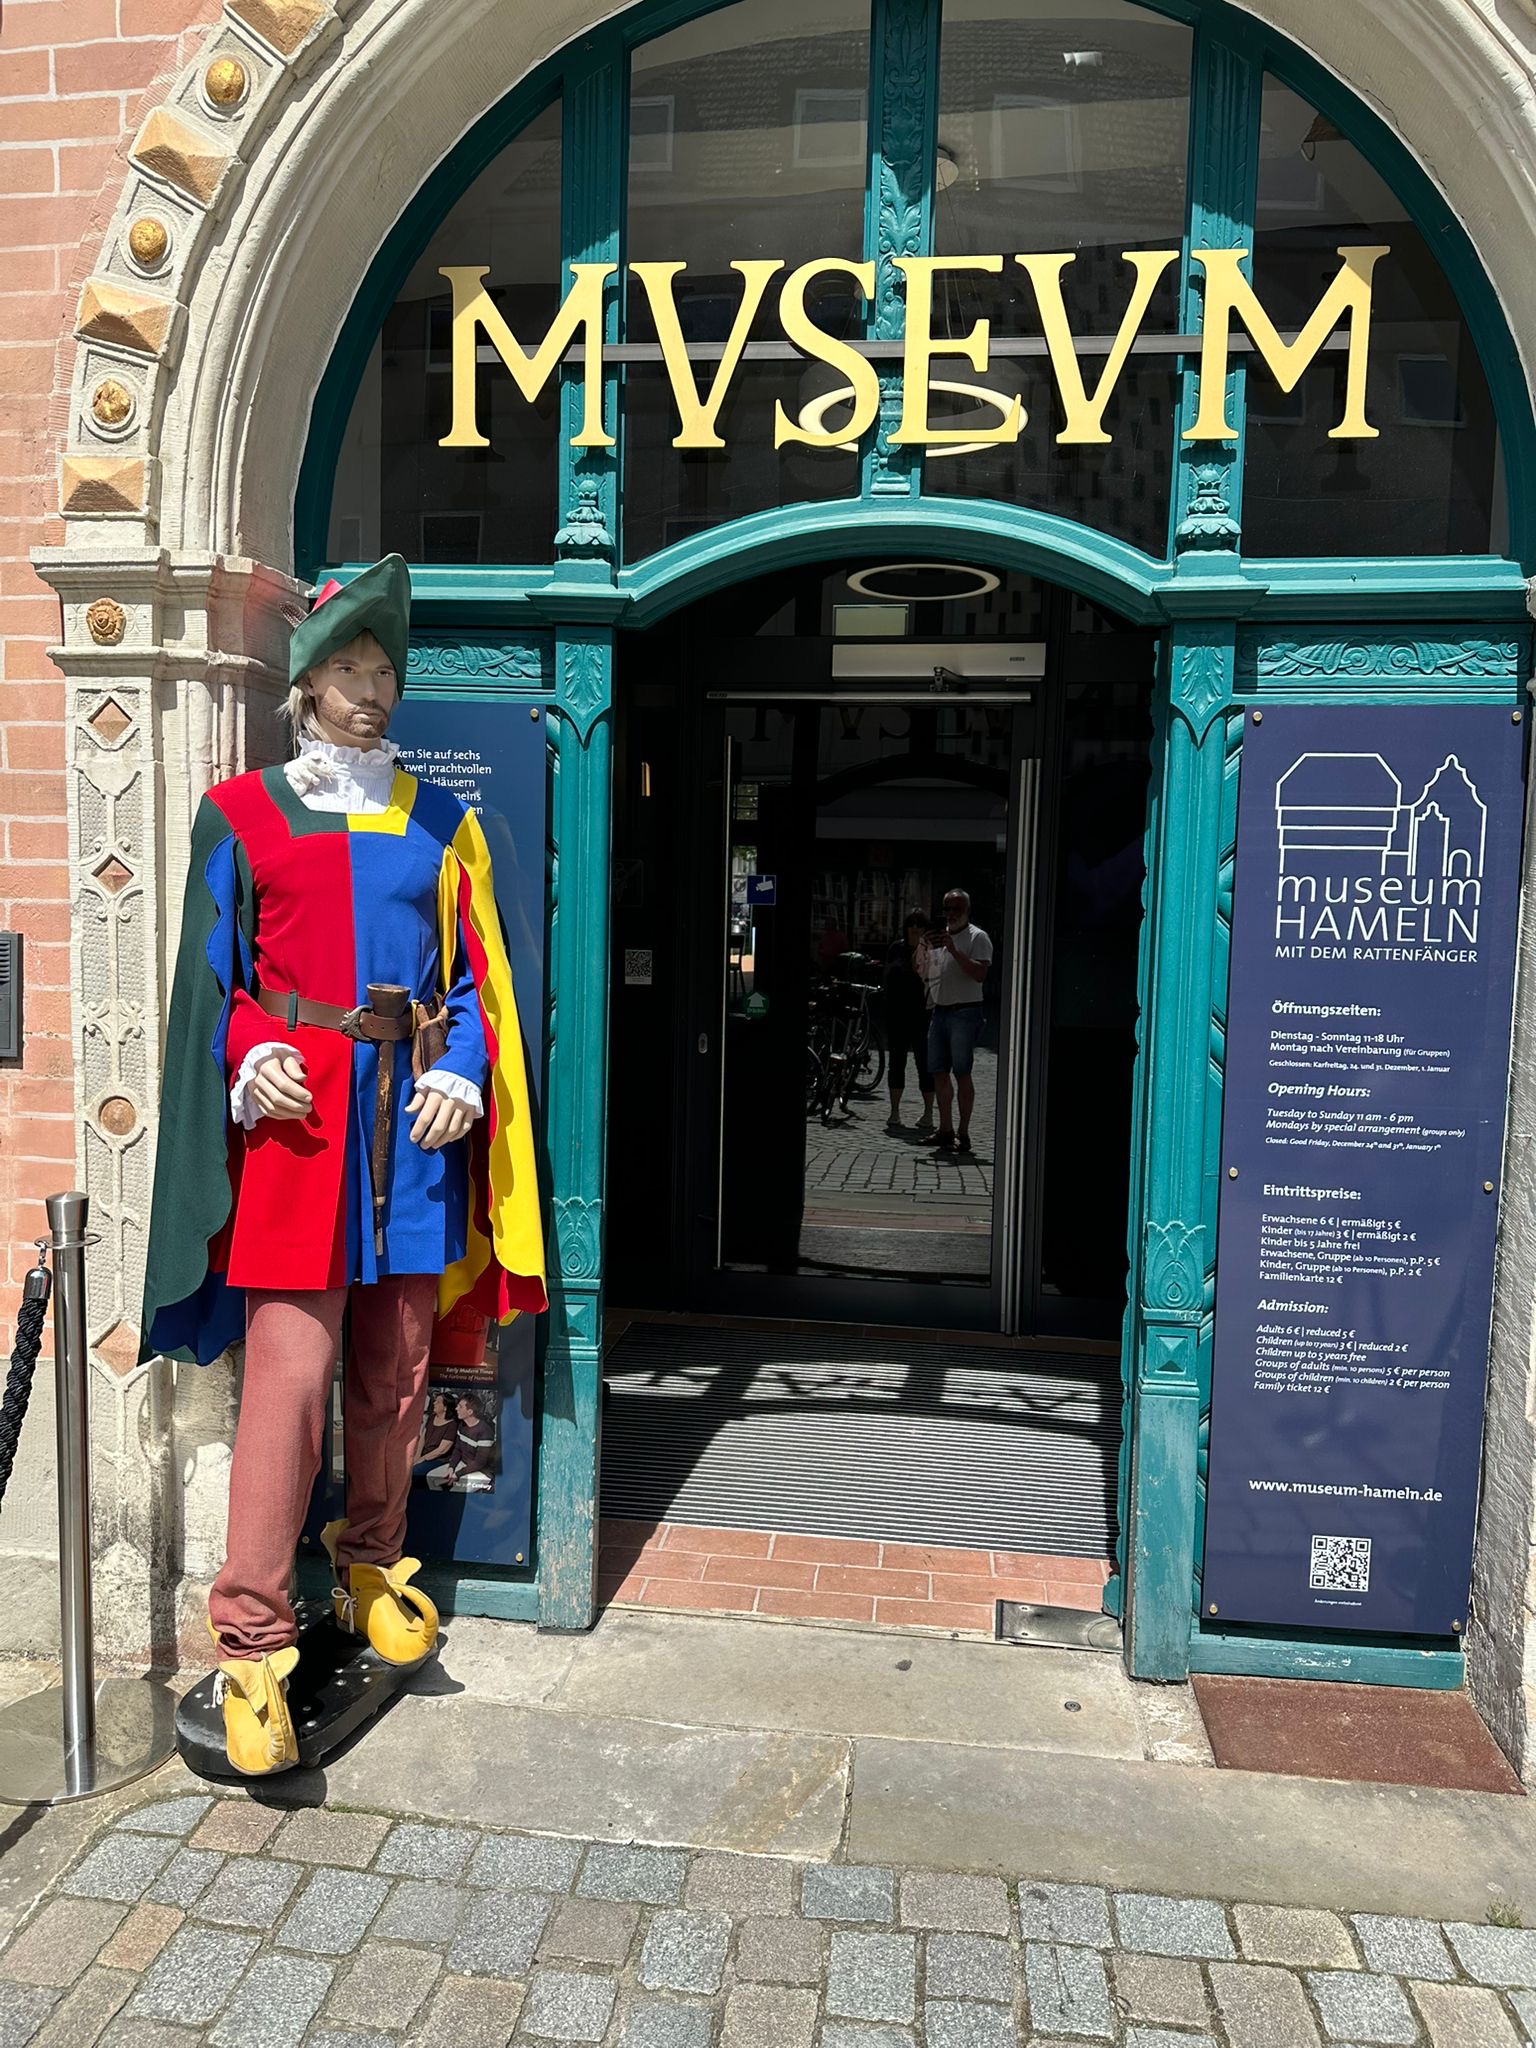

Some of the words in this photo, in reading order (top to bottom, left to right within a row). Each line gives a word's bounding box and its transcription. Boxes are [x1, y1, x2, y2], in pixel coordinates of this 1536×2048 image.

[438, 245, 1391, 450] MVSEVM
[416, 748, 432, 759] Sie
[433, 749, 452, 759] auf
[453, 749, 480, 760] sechs
[403, 762, 426, 772] zwei
[429, 762, 492, 775] prachtvollen
[1276, 875, 1481, 904] museum
[1275, 904, 1478, 943] HAMELN
[1275, 945, 1305, 958] MIT
[1310, 946, 1346, 959] DEM
[1353, 947, 1477, 962] RATTENFÄNGER
[1271, 999, 1381, 1018] Öffnungszeiten:
[1270, 1030, 1313, 1043] Dienstag
[1321, 1032, 1361, 1044] Sonntag
[1363, 1033, 1384, 1042] 11-18
[1386, 1034, 1404, 1043] Uhr
[1269, 1042, 1308, 1054] Montag
[1309, 1043, 1333, 1052] nach
[1335, 1044, 1401, 1057] Vereinbarung
[1403, 1048, 1416, 1056] (für
[1417, 1049, 1450, 1057] Gruppen)
[1268, 1059, 1312, 1067] Geschlossen:
[1384, 1064, 1420, 1072] Dezember,
[1267, 1082, 1325, 1098] Opening
[1327, 1085, 1371, 1097] Hours:
[1267, 1108, 1306, 1120] Tuesday
[1307, 1110, 1318, 1118] to
[1319, 1110, 1355, 1122] Sunday
[1365, 1113, 1382, 1121] am
[1389, 1113, 1398, 1123] 6
[1397, 1115, 1414, 1124] pm
[1265, 1119, 1309, 1132] Mondays
[1310, 1121, 1323, 1133] by
[1324, 1122, 1357, 1133] special
[1357, 1125, 1421, 1135] arrangement
[1421, 1127, 1447, 1136] (groups
[1448, 1129, 1465, 1138] only)
[1265, 1136, 1288, 1144] Closed:
[1308, 1138, 1331, 1147] Friday,
[1331, 1139, 1365, 1147] December
[1405, 1143, 1433, 1152] January
[1263, 1184, 1361, 1201] Eintrittspreise:
[1262, 1213, 1318, 1225] Erwachsene
[1319, 1216, 1326, 1225] 6
[1327, 1217, 1334, 1225] €
[1341, 1218, 1386, 1230] ermäßigt
[1387, 1221, 1393, 1230] 5
[1394, 1220, 1401, 1229] €
[1261, 1225, 1293, 1235] Kinder
[1336, 1230, 1341, 1239] 3
[1343, 1229, 1349, 1238] €
[1356, 1230, 1401, 1243] ermäßigt
[1402, 1233, 1408, 1241] 2
[1409, 1232, 1416, 1241] €
[1260, 1236, 1292, 1246] Kinder
[1293, 1237, 1308, 1247] bis
[1309, 1240, 1315, 1249] 5
[1316, 1239, 1342, 1249] Jahre
[1343, 1240, 1360, 1250] frei
[1260, 1248, 1316, 1260] Erwachsene,
[1316, 1251, 1351, 1263] Gruppe
[1352, 1254, 1364, 1262] (ab
[1373, 1255, 1408, 1265] Personen),
[1409, 1256, 1426, 1266] p.P.
[1427, 1258, 1433, 1267] 5
[1433, 1257, 1440, 1266] €
[1259, 1259, 1293, 1270] Kinder,
[1295, 1261, 1331, 1273] Gruppe
[1352, 1266, 1387, 1275] Personen),
[1389, 1266, 1406, 1277] p.P.
[1408, 1268, 1414, 1276] 2
[1415, 1267, 1422, 1276] €
[1259, 1271, 1324, 1282] Familienkarte
[1336, 1275, 1343, 1284] €
[1256, 1299, 1329, 1313] Admission:
[1256, 1324, 1285, 1334] Adults
[1286, 1325, 1293, 1334] 6
[1293, 1326, 1300, 1335] €
[1305, 1327, 1341, 1337] reduced
[1341, 1331, 1348, 1339] 5
[1348, 1329, 1356, 1338] €
[1256, 1335, 1293, 1346] Children
[1339, 1342, 1345, 1350] 3
[1346, 1341, 1353, 1349] €
[1358, 1341, 1394, 1351] reduced
[1401, 1343, 1408, 1352] €
[1255, 1346, 1292, 1357] Children
[1294, 1351, 1306, 1359] up
[1307, 1350, 1317, 1359] to
[1317, 1352, 1325, 1361] 5
[1324, 1352, 1349, 1363] years
[1348, 1351, 1367, 1363] free
[1254, 1358, 1288, 1370] Groups
[1289, 1360, 1301, 1371] of
[1300, 1361, 1330, 1371] adults
[1385, 1367, 1392, 1376] 5
[1393, 1366, 1400, 1375] €
[1401, 1368, 1419, 1377] per
[1418, 1369, 1450, 1378] person
[1253, 1380, 1285, 1393] Family
[1286, 1382, 1312, 1392] ticket
[1323, 1385, 1331, 1393] €
[1254, 1369, 1289, 1381] Groups
[1288, 1371, 1301, 1382] of
[1300, 1372, 1334, 1382] children
[1388, 1378, 1394, 1386] 2
[1395, 1377, 1403, 1386] €
[1402, 1380, 1419, 1388] per
[1419, 1381, 1450, 1389] person
[1248, 1480, 1442, 1501] www.museum-hameln.de
